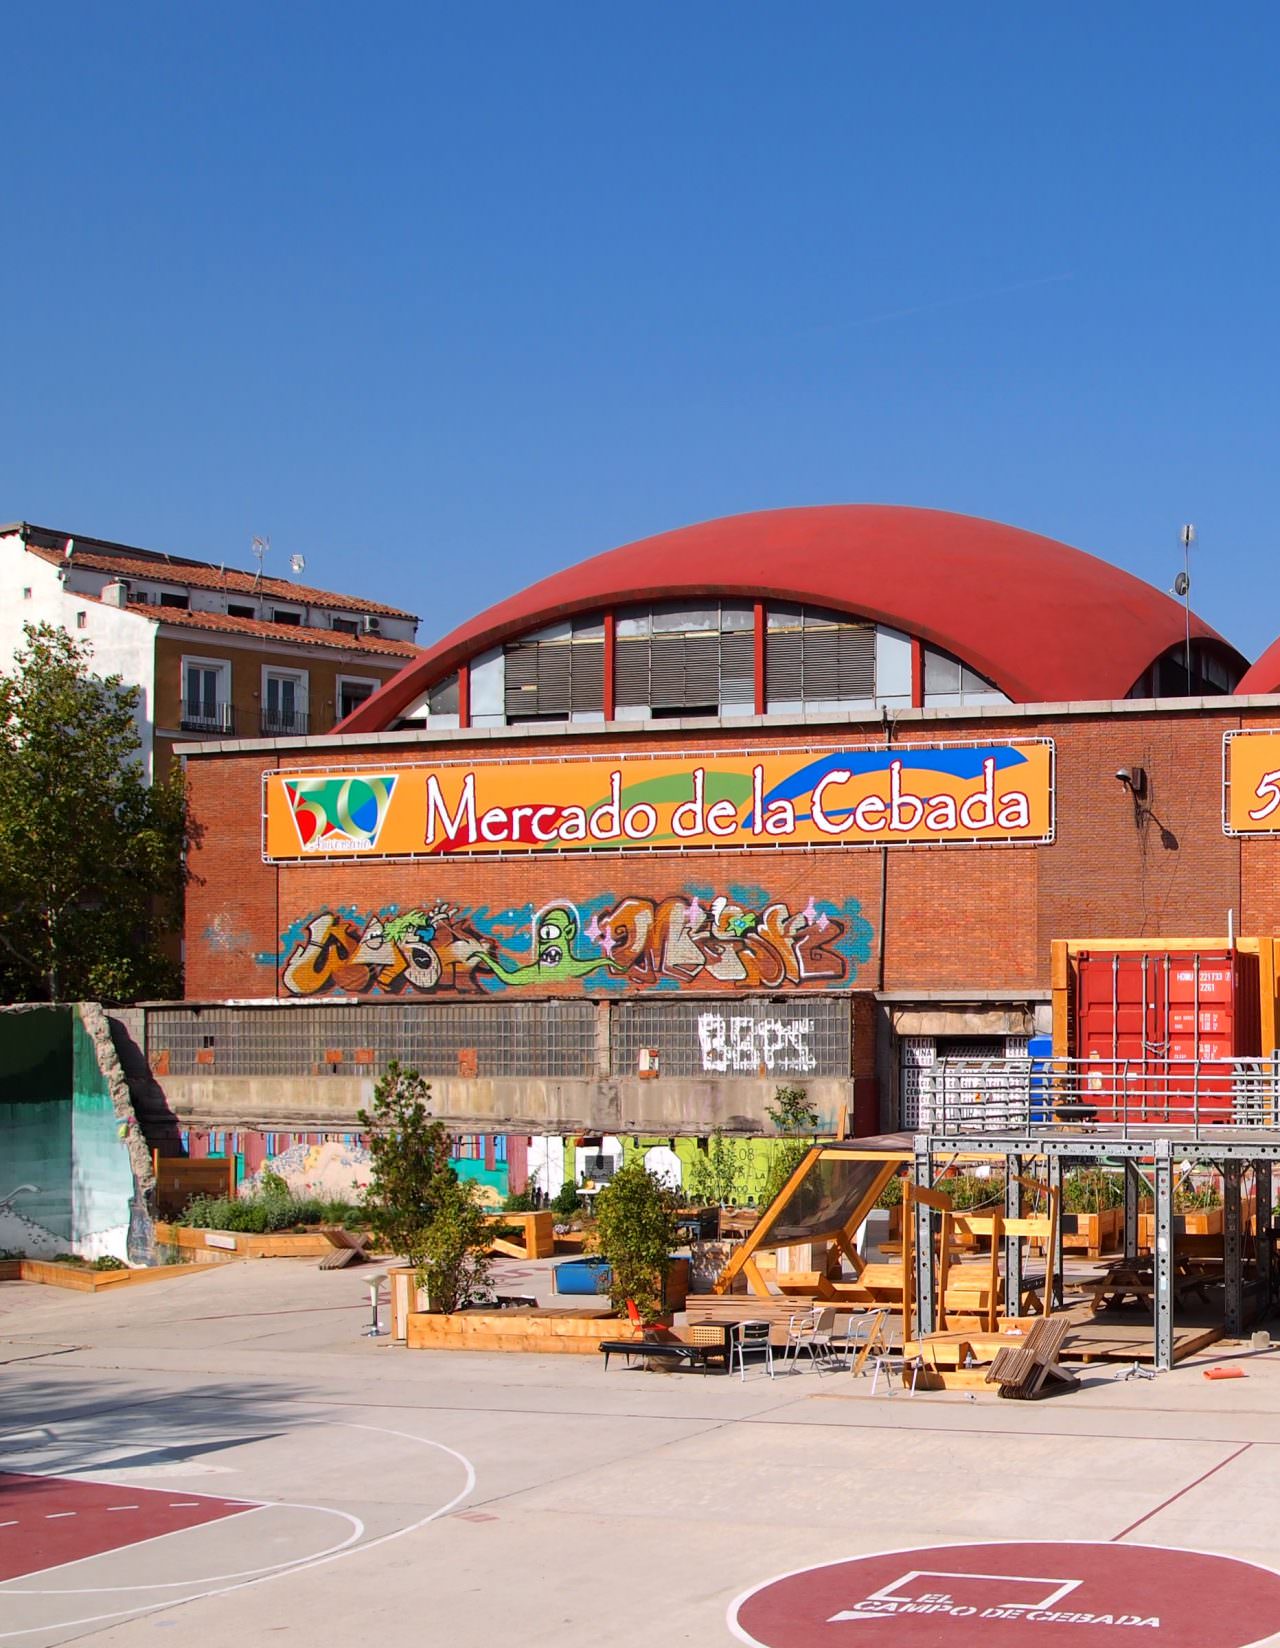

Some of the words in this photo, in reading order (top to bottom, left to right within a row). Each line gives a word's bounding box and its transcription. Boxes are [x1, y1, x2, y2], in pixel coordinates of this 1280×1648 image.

[424, 771, 657, 845] Mercado
[672, 767, 737, 837] de
[752, 764, 795, 836] la
[811, 757, 1029, 834] Cebada
[916, 1594, 954, 1603] EL
[853, 1601, 977, 1617] CAMPO
[980, 1608, 1024, 1619] DE
[1026, 1610, 1161, 1627] CEBADA
